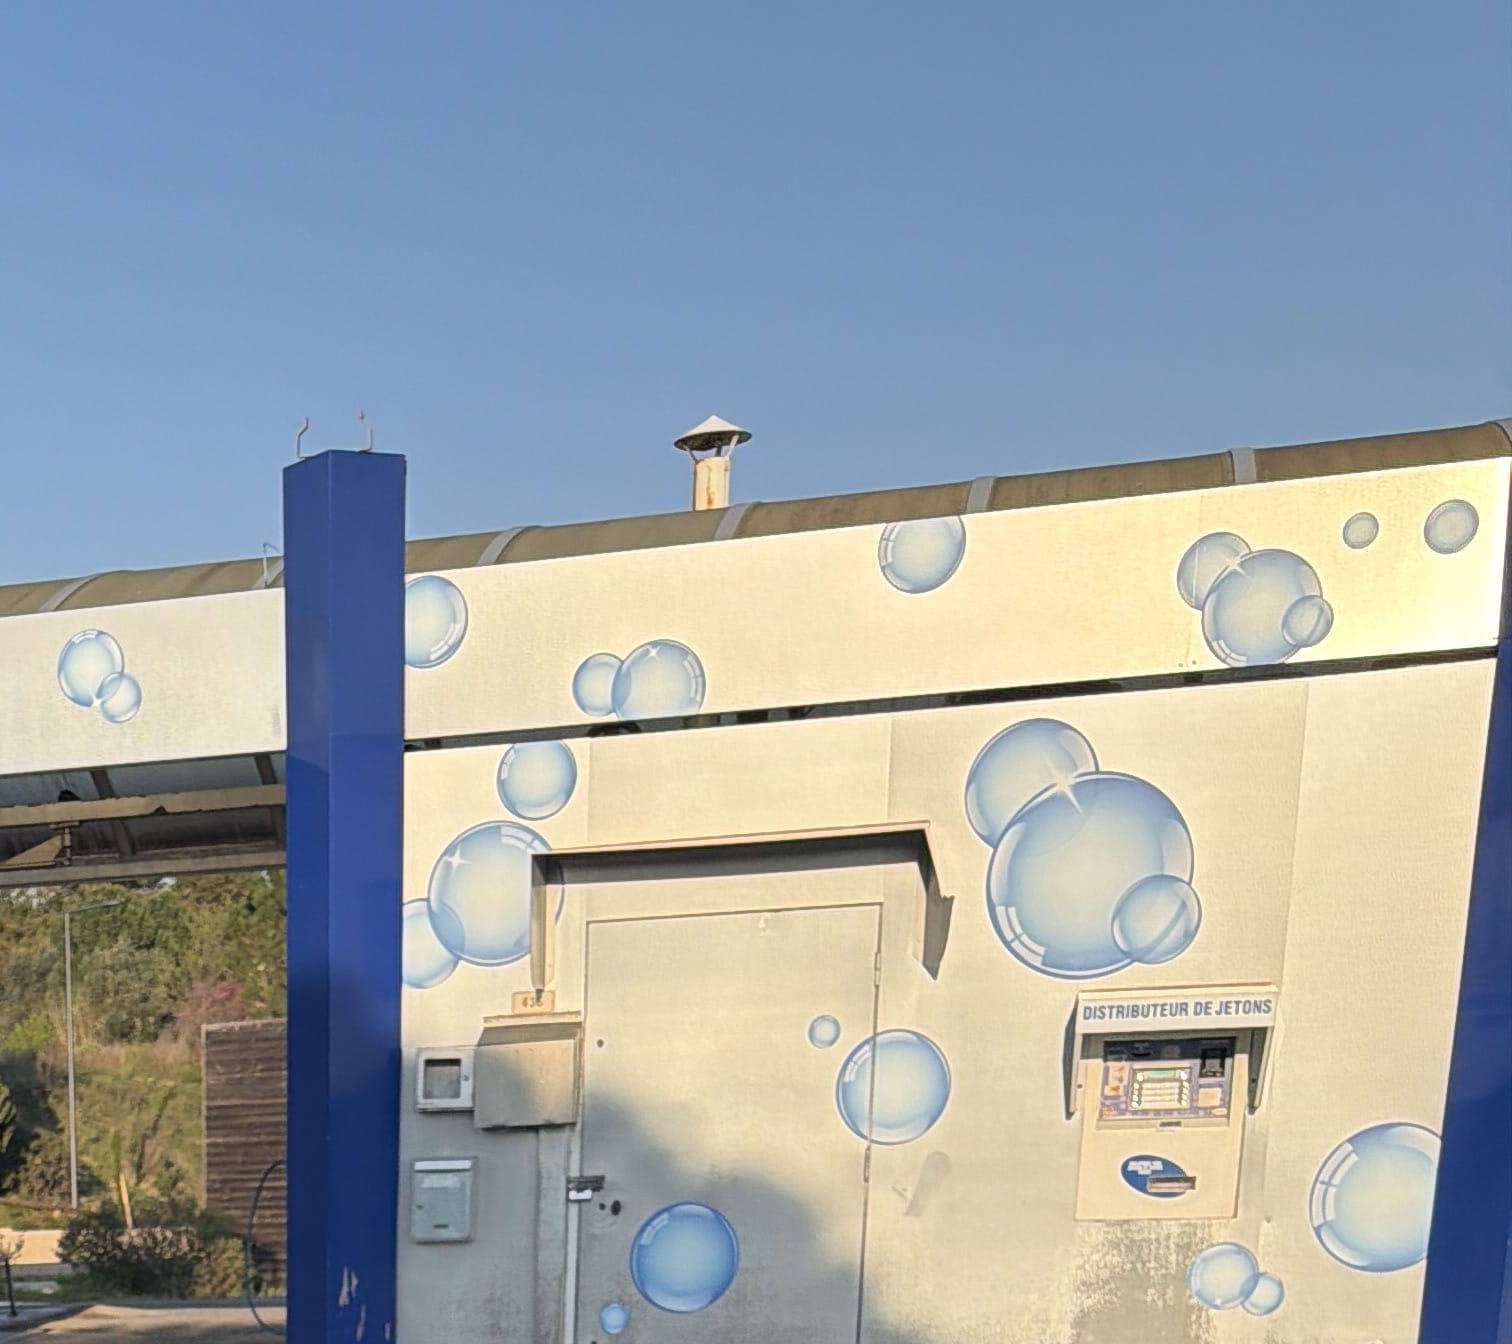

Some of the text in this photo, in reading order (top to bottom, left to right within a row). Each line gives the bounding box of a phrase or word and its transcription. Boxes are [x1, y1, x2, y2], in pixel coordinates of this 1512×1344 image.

[1083, 999, 1273, 1020] DISTRIBUTEUR DE JETONS
